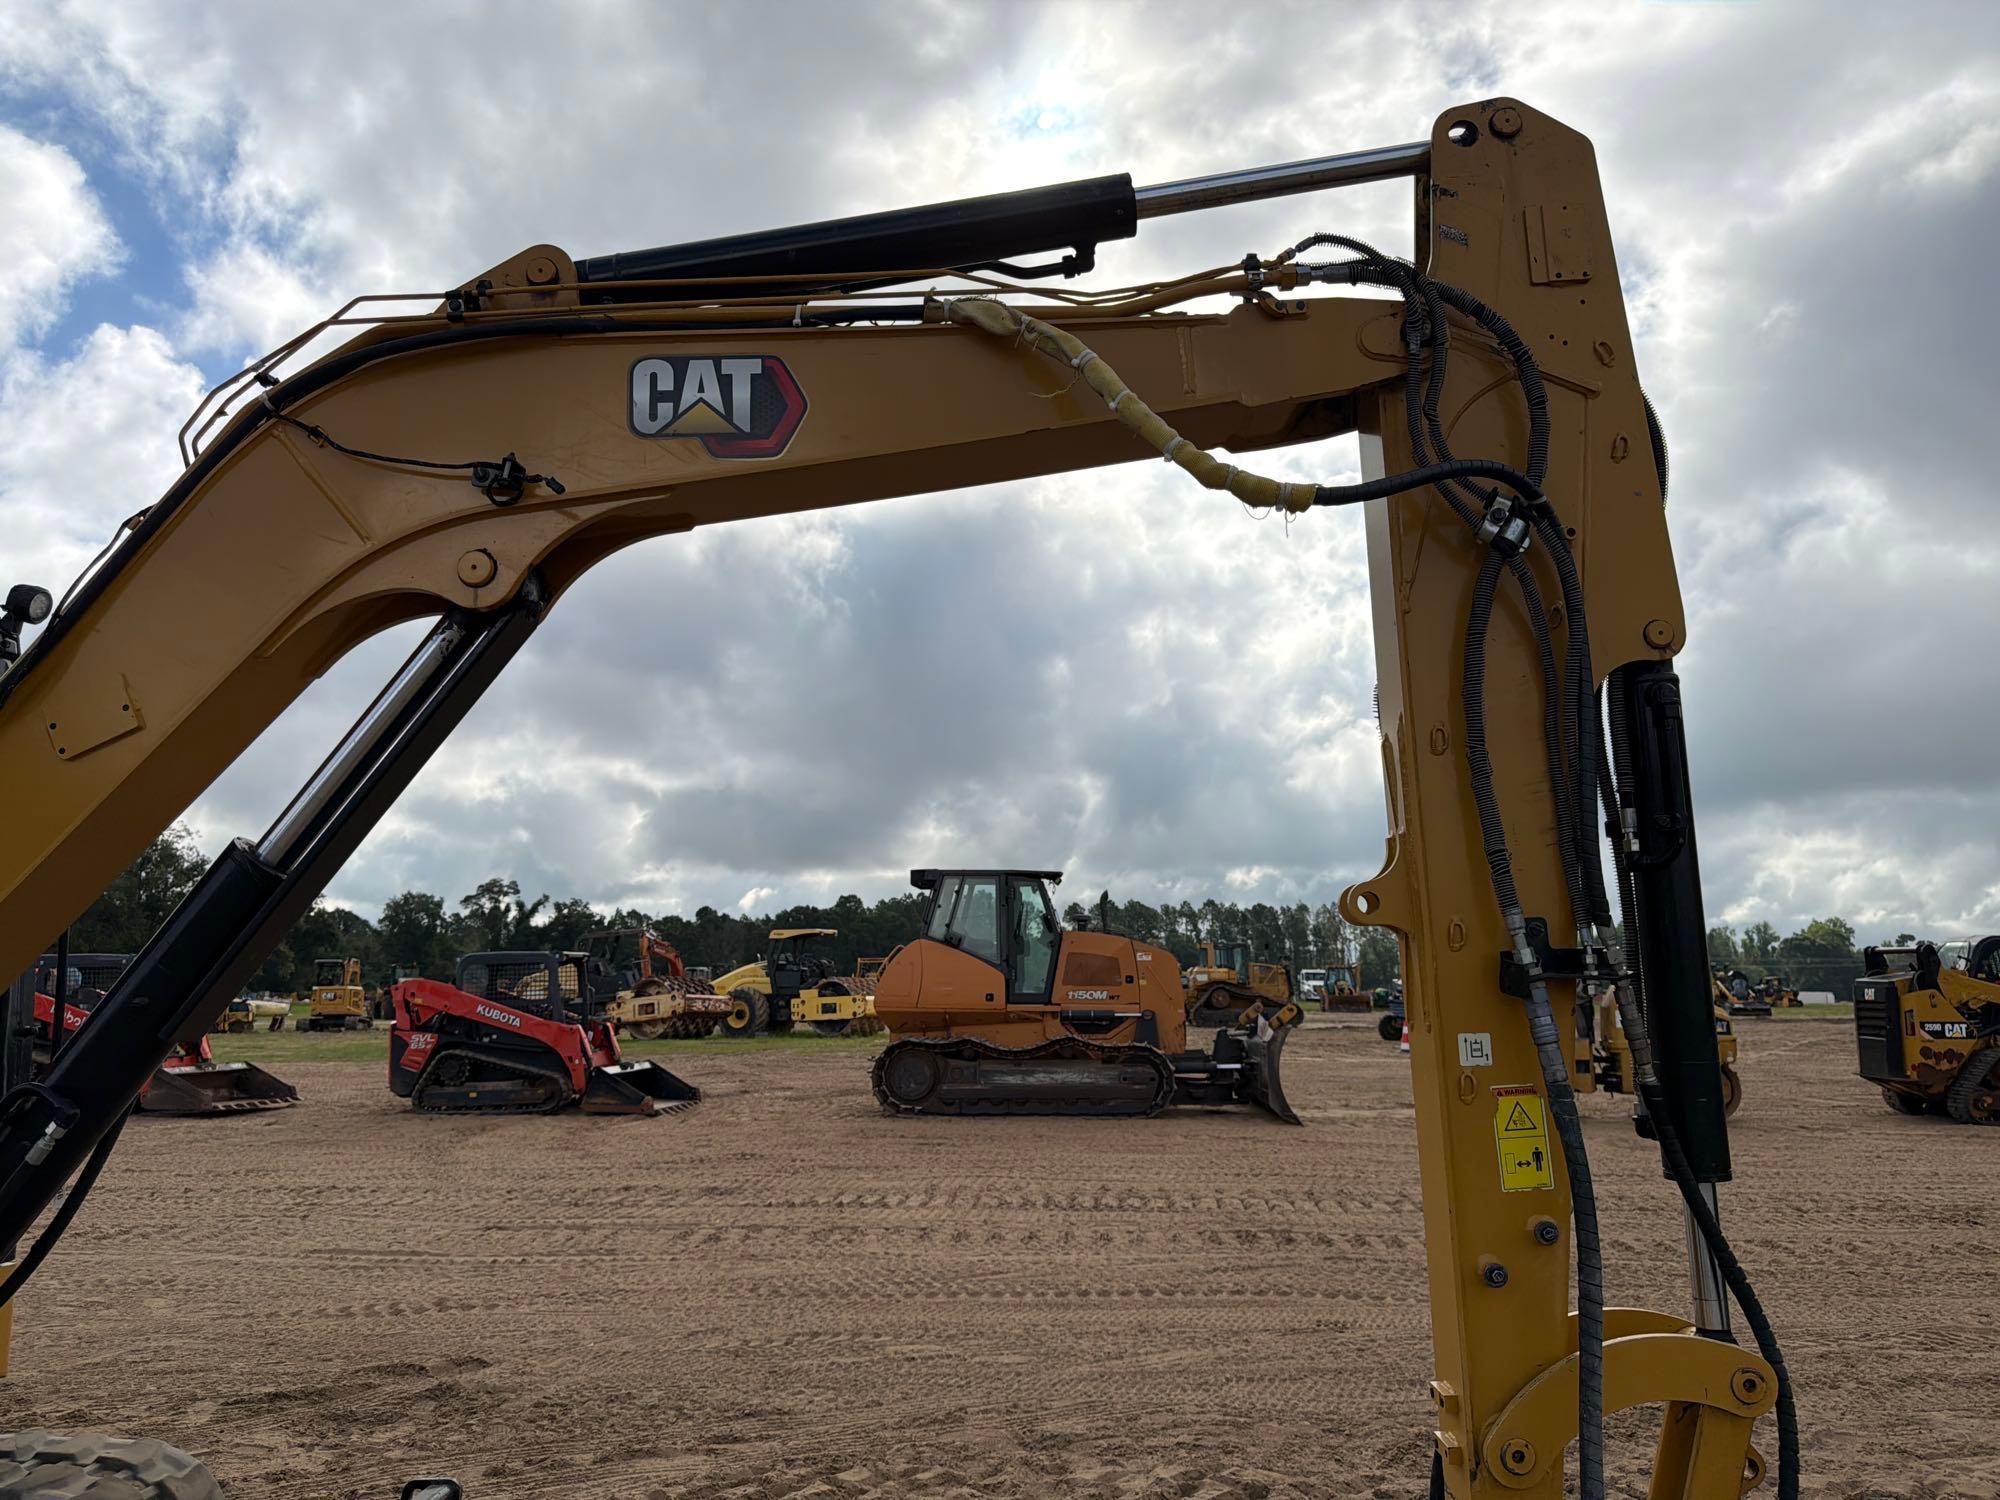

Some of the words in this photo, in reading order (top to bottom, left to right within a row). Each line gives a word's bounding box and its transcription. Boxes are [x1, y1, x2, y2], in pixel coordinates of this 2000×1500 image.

[632, 357, 763, 435] CAT
[322, 992, 336, 1001] CAT
[1864, 988, 1875, 1001] CAT
[475, 1003, 522, 1028] KUBOTA
[1717, 1020, 1728, 1032] AT
[1944, 1023, 1968, 1038] CAT
[410, 1033, 435, 1043] SVL
[1484, 1053, 1489, 1062] 1
